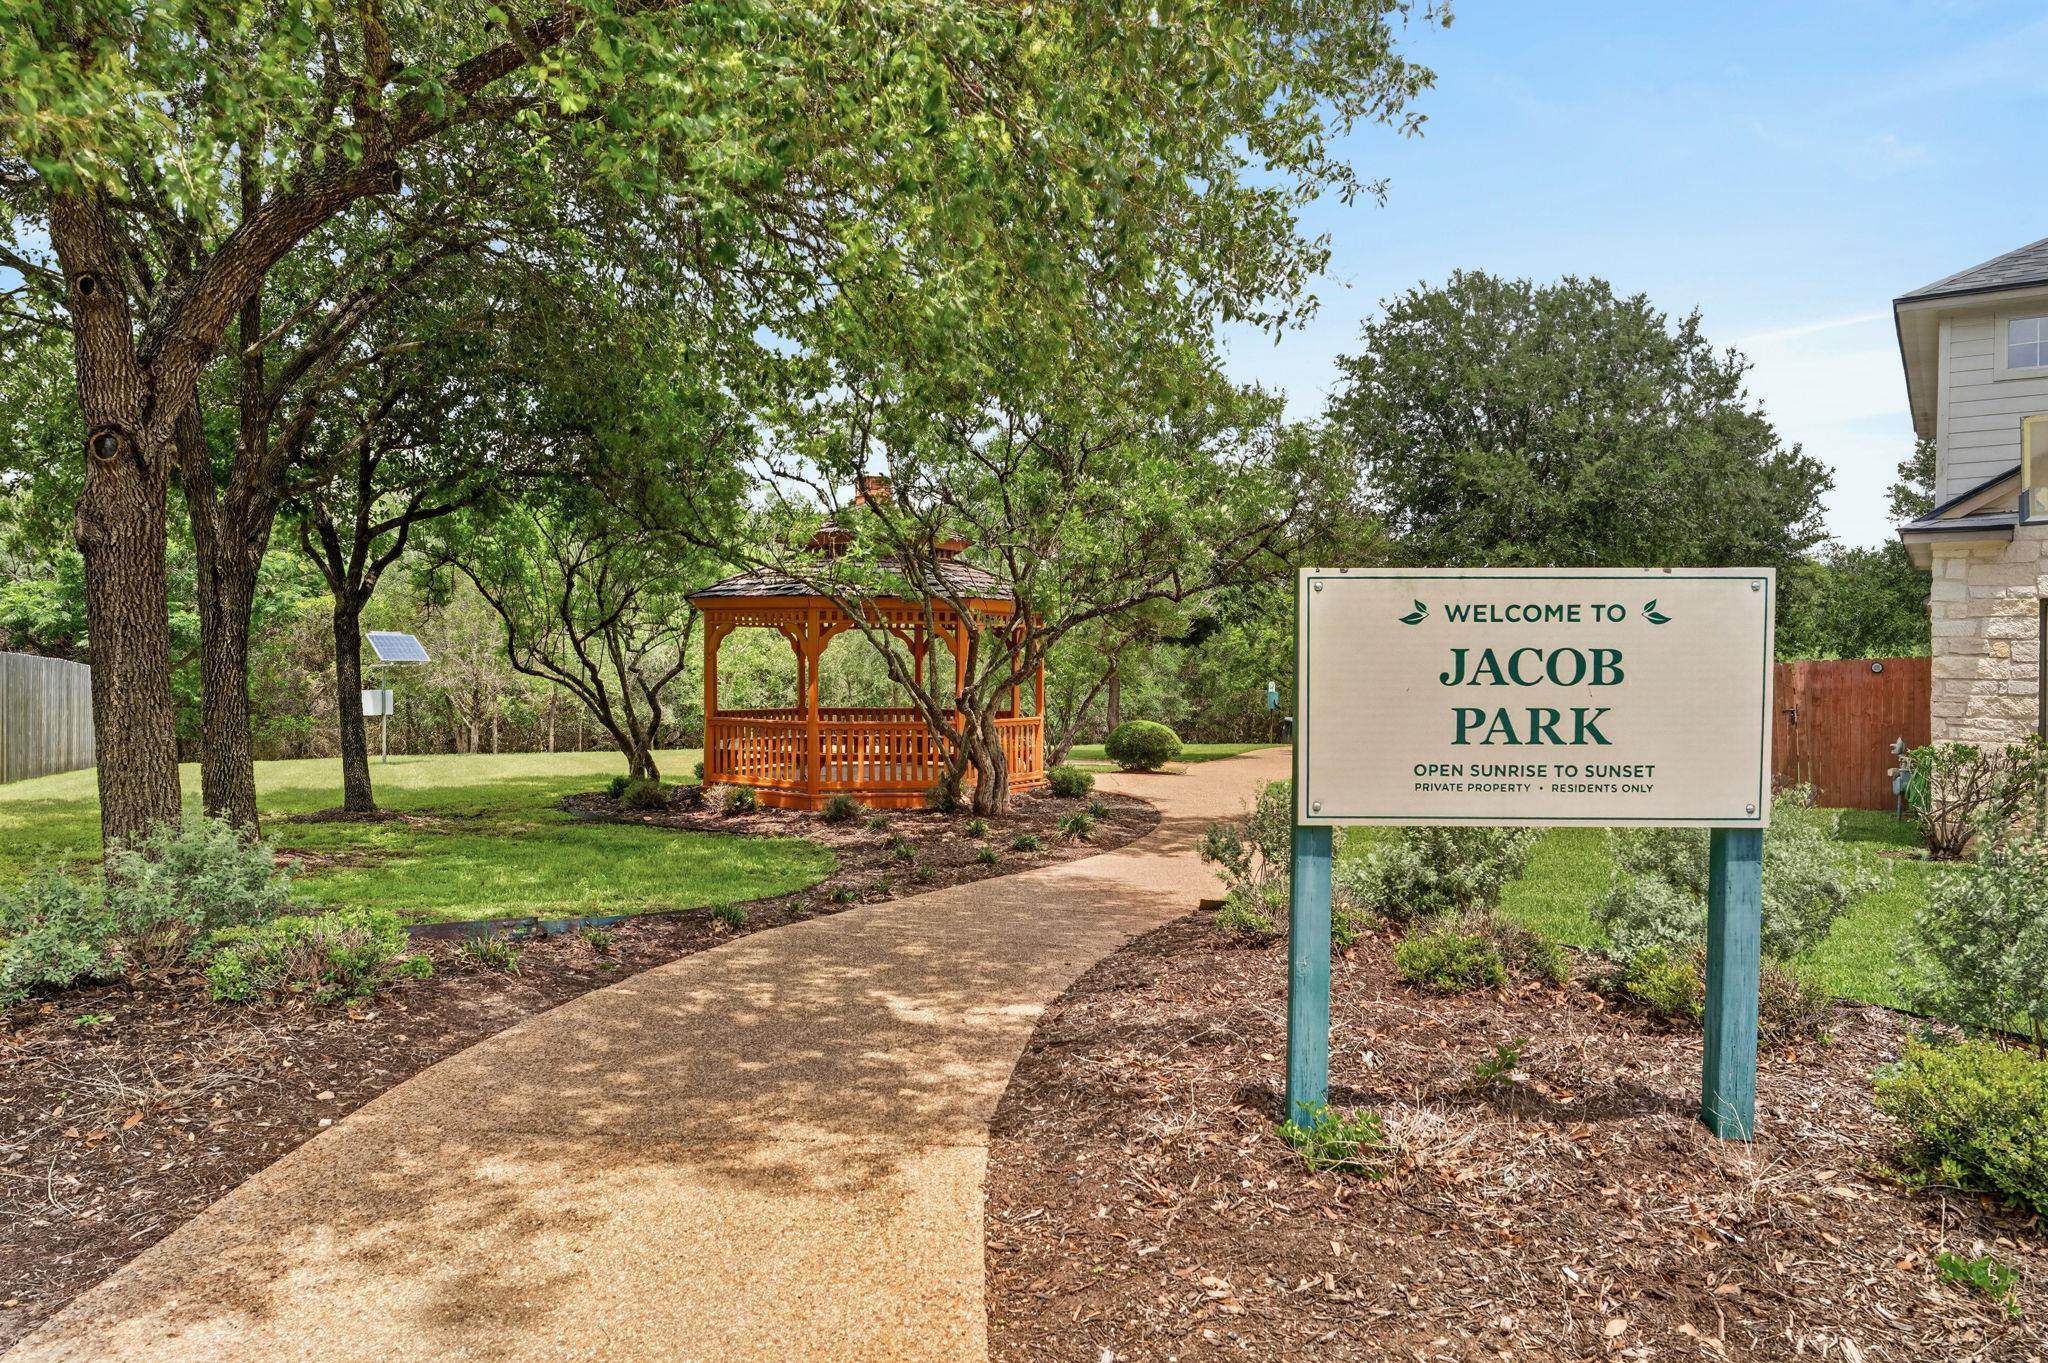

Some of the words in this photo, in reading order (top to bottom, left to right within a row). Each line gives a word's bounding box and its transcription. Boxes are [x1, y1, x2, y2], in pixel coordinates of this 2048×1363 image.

[1444, 604, 1581, 623] WELCOME
[1591, 604, 1627, 623] TO
[1439, 647, 1625, 687] JACOB
[1450, 707, 1613, 745] PARK
[1413, 763, 1464, 777] OPEN
[1470, 764, 1548, 778] SUNRISE
[1553, 764, 1579, 778] TO
[1585, 764, 1656, 778] SUNSET
[1414, 782, 1464, 793] PRIVATE
[1467, 783, 1532, 793] PROPERTY
[1551, 783, 1618, 793] RESIDENTS
[1621, 783, 1654, 793] ONLY
